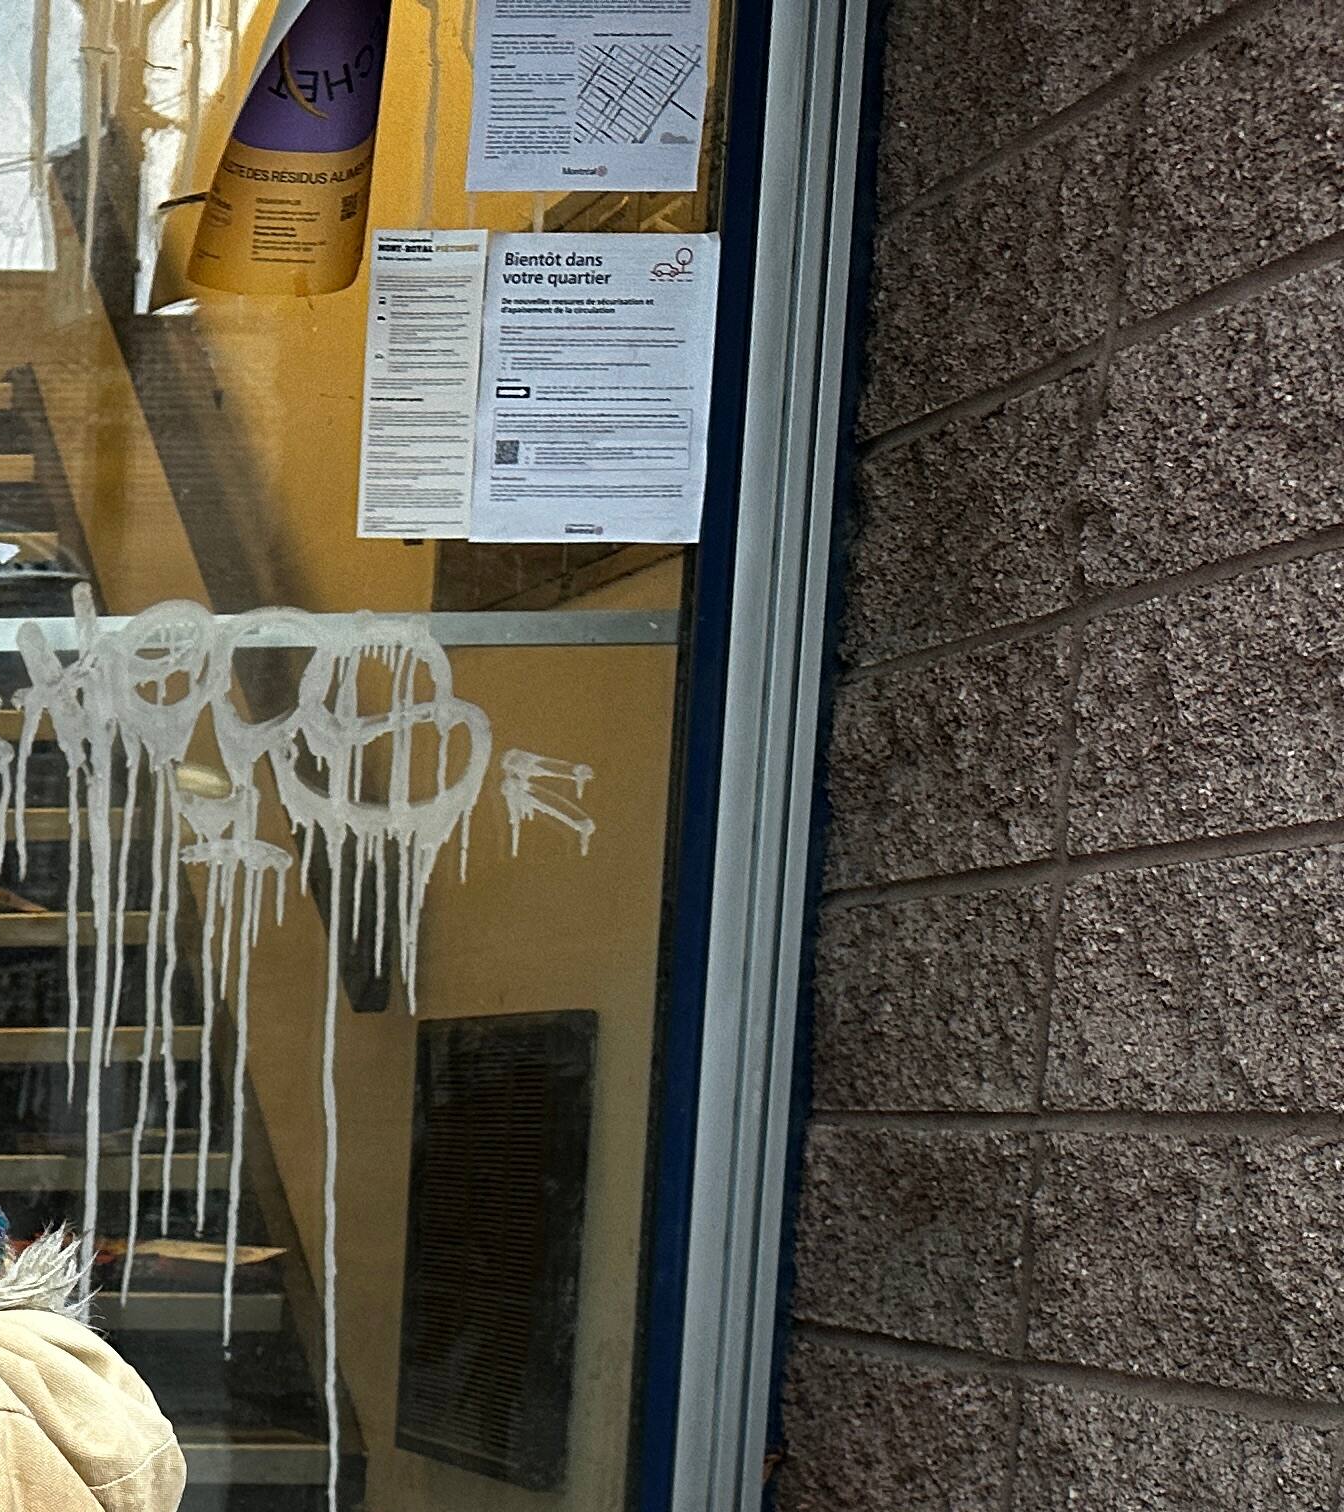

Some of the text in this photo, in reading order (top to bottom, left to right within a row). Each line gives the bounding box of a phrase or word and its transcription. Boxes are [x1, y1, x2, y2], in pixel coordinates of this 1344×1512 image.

[246, 167, 269, 182] DES
[271, 167, 328, 185] RÉSIDUS
[505, 251, 604, 267] Bientôt dans
[502, 270, 612, 288] votre quartier
[513, 298, 550, 306] nouvelles
[585, 298, 596, 306] de
[597, 298, 644, 306] sécurisation
